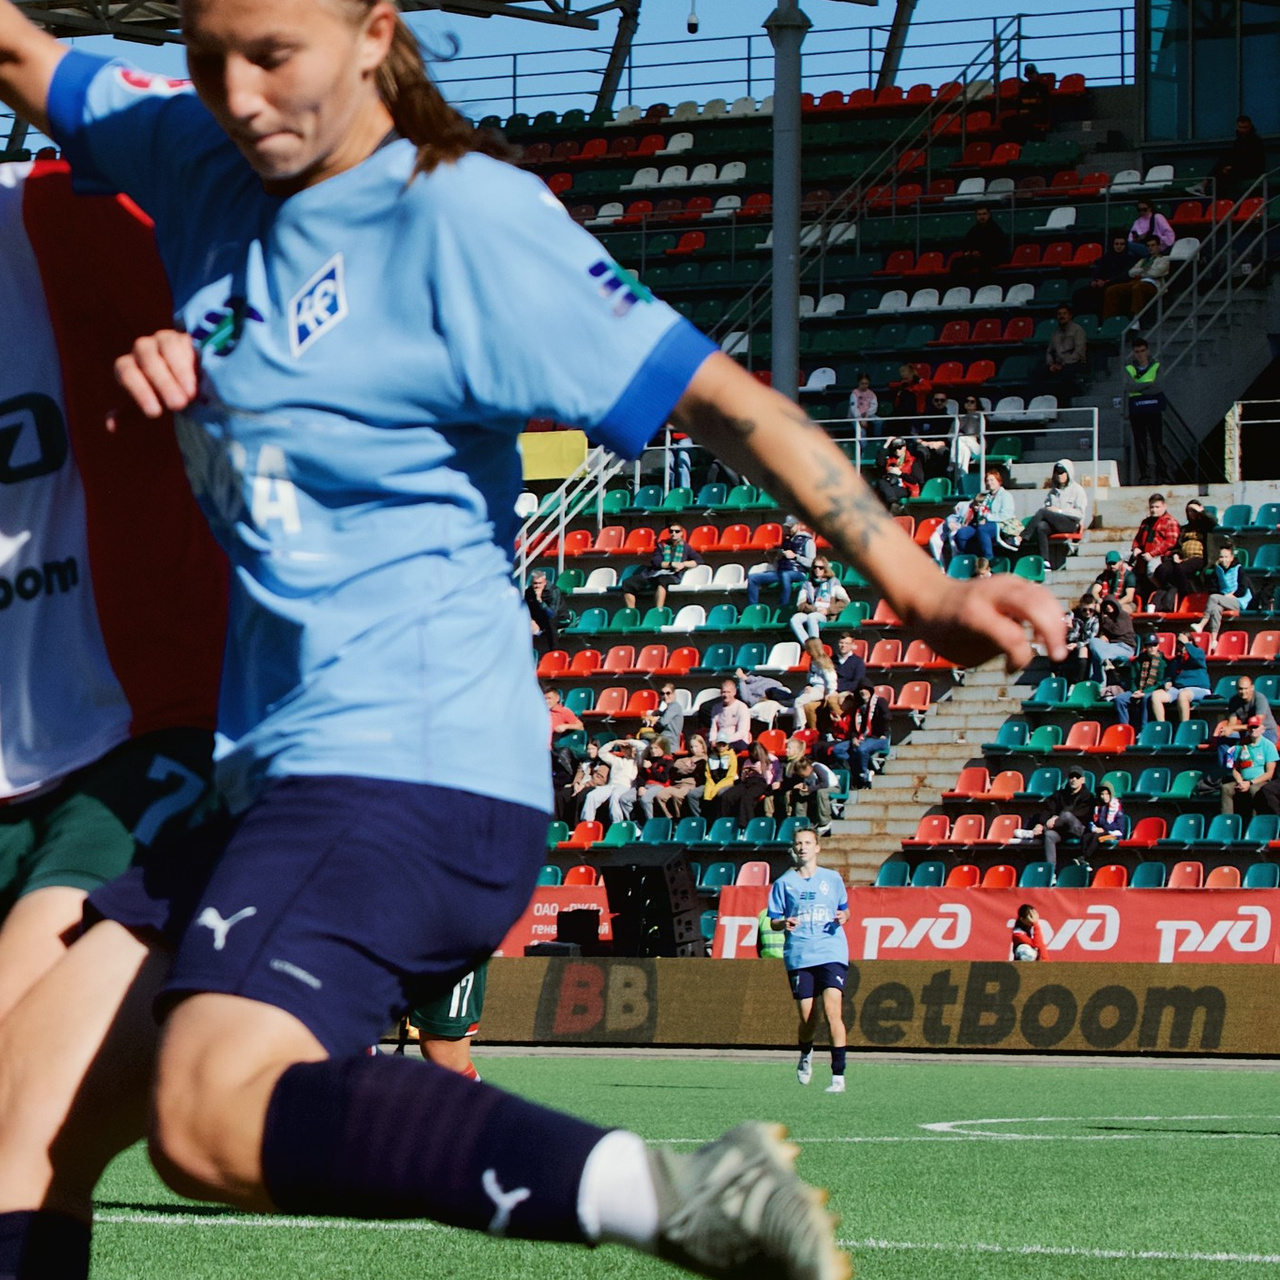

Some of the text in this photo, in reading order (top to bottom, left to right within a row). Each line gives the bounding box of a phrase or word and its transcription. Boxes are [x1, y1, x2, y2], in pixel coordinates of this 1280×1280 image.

[534, 902, 559, 916] ОАО
[448, 970, 475, 1018] 17
[553, 963, 650, 1035] BB
